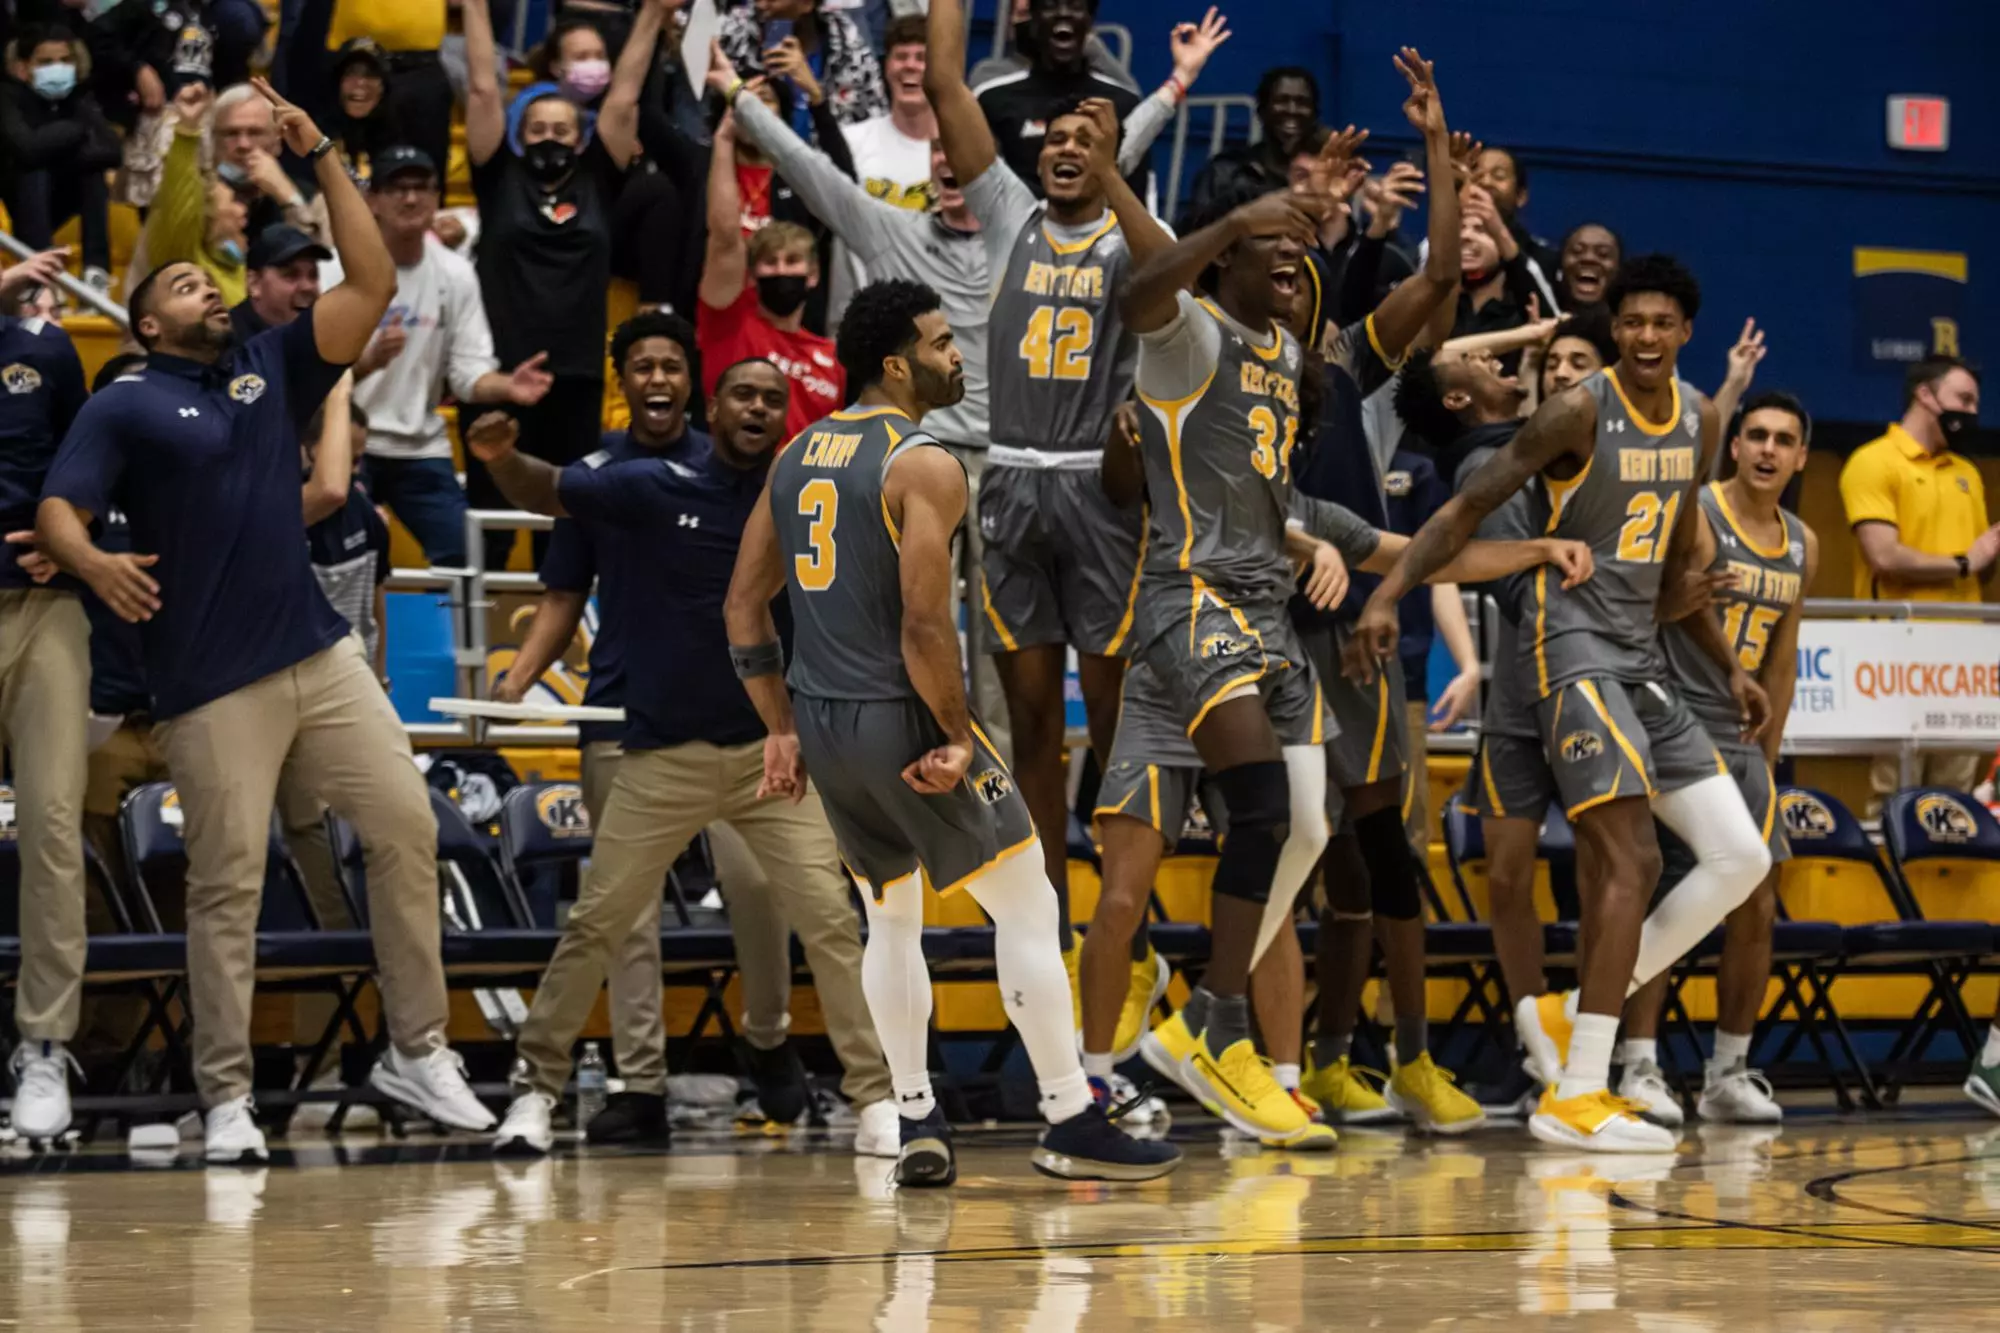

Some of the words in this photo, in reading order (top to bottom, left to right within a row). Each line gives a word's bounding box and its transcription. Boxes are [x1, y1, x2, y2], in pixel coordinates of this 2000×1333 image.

[1019, 305, 1093, 380] 42
[801, 431, 863, 468] CARRY
[795, 478, 838, 591] 3
[1615, 490, 1681, 564] 21
[1723, 601, 1783, 671] 15
[1792, 687, 1835, 713] TER
[1855, 661, 2000, 700] QUICKCARE
